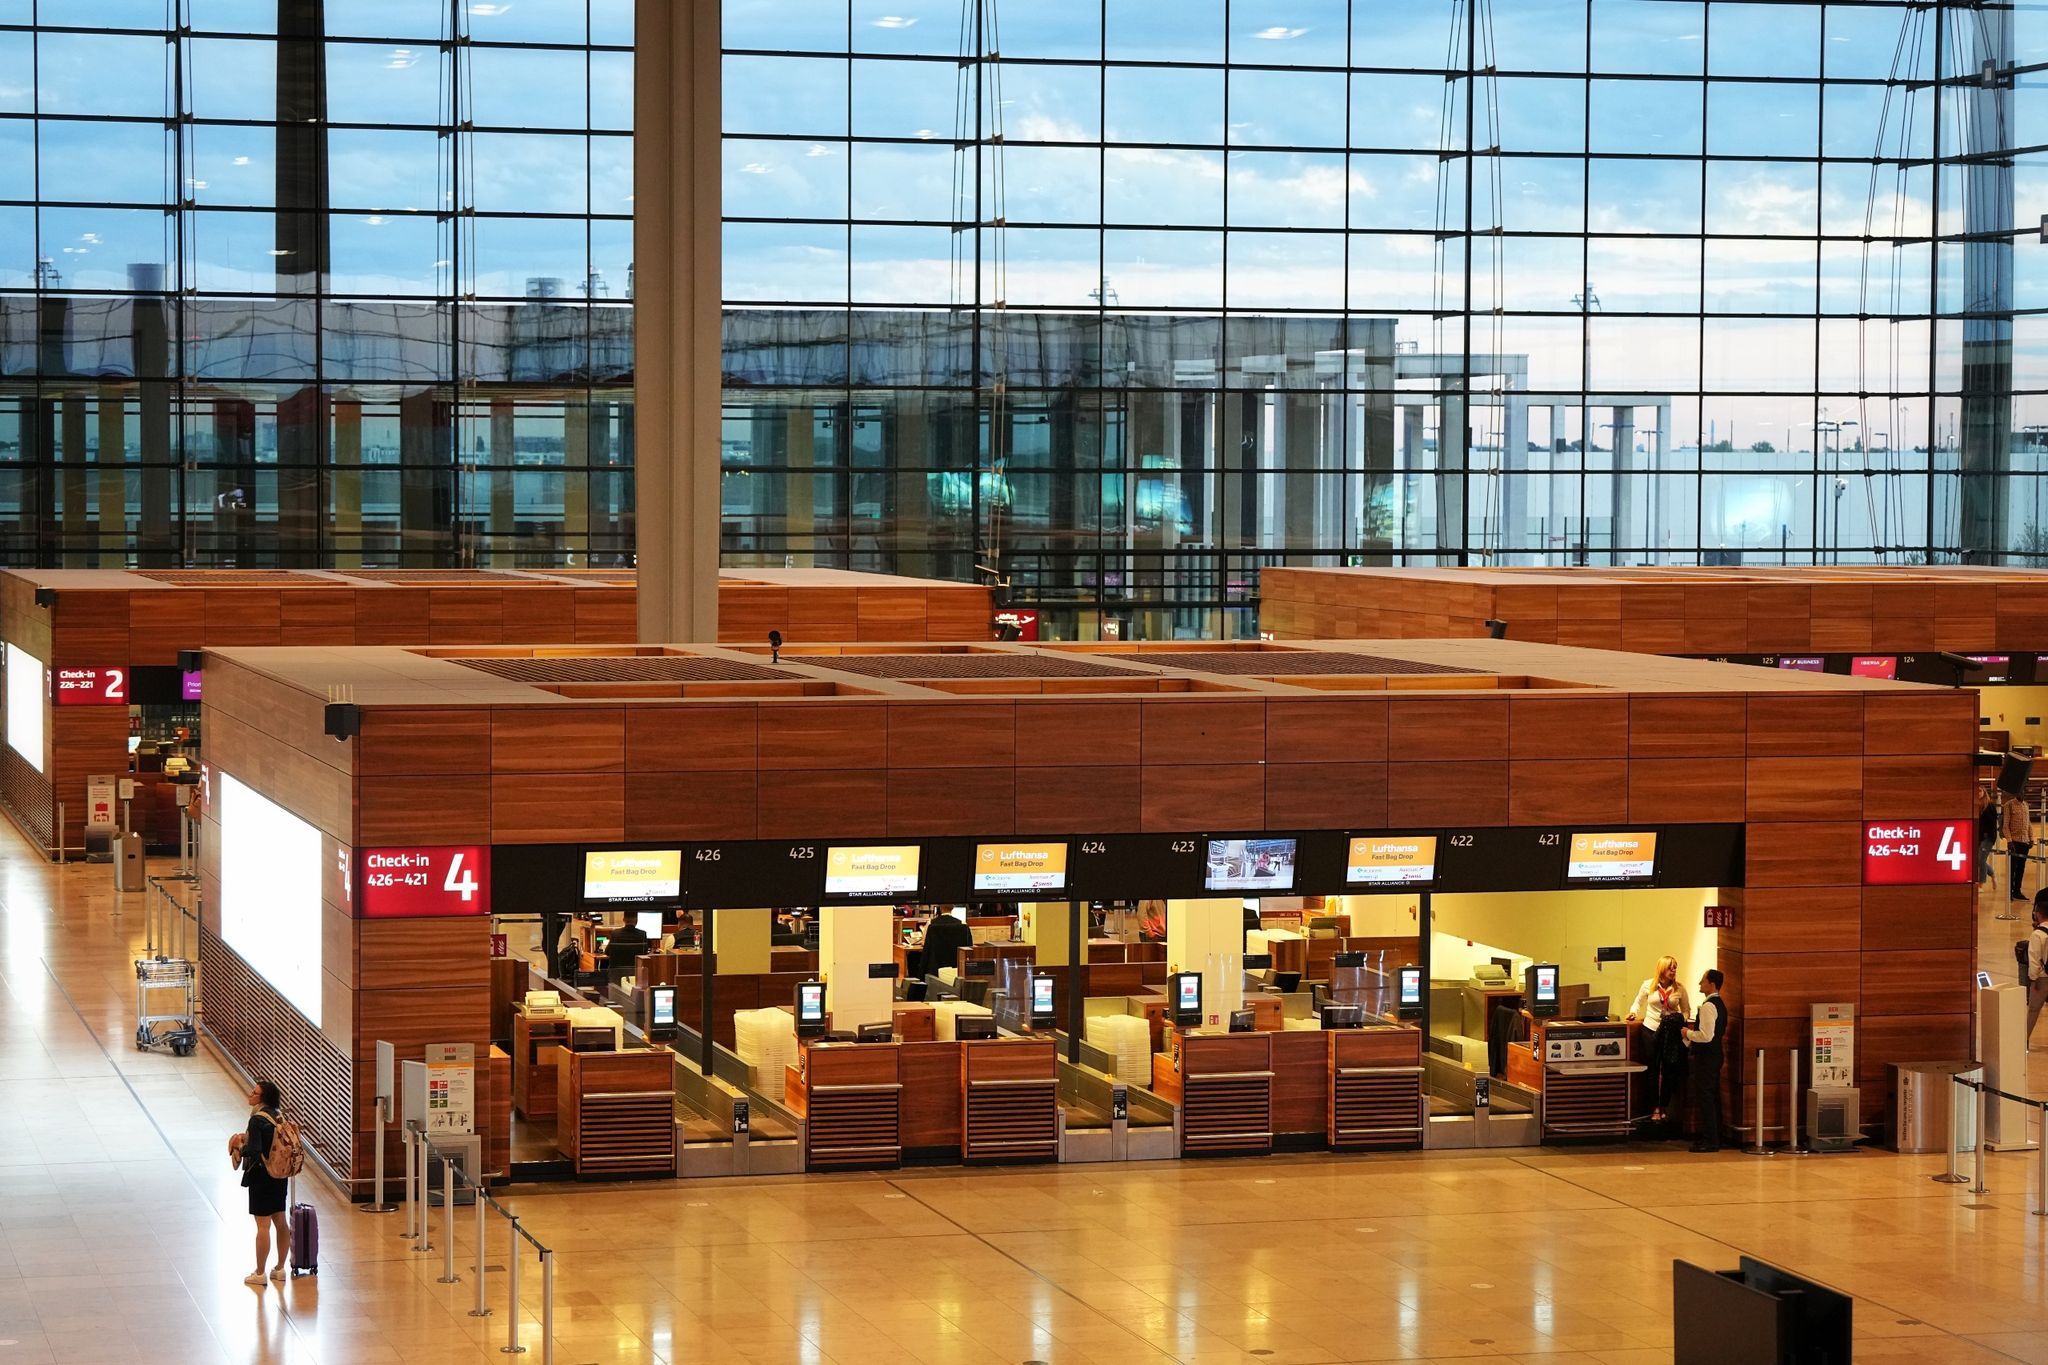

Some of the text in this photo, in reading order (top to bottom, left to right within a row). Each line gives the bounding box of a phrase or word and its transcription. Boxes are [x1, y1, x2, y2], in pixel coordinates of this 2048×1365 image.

[60, 670, 95, 678] Check-in
[105, 670, 124, 698] 2
[1869, 827, 1920, 839] Check-in
[1450, 835, 1473, 846] 422
[1539, 834, 1560, 845] 421
[1593, 840, 1638, 848] Lufthansa
[1082, 842, 1106, 853] 424
[1172, 841, 1194, 852] 423
[1372, 844, 1418, 852] Lufthansa
[1936, 827, 1966, 870] 4
[696, 849, 721, 861] 426
[789, 847, 814, 858] 425
[1000, 851, 1048, 859] Lufthansa
[368, 854, 429, 867] Check-in
[444, 853, 478, 901] 4
